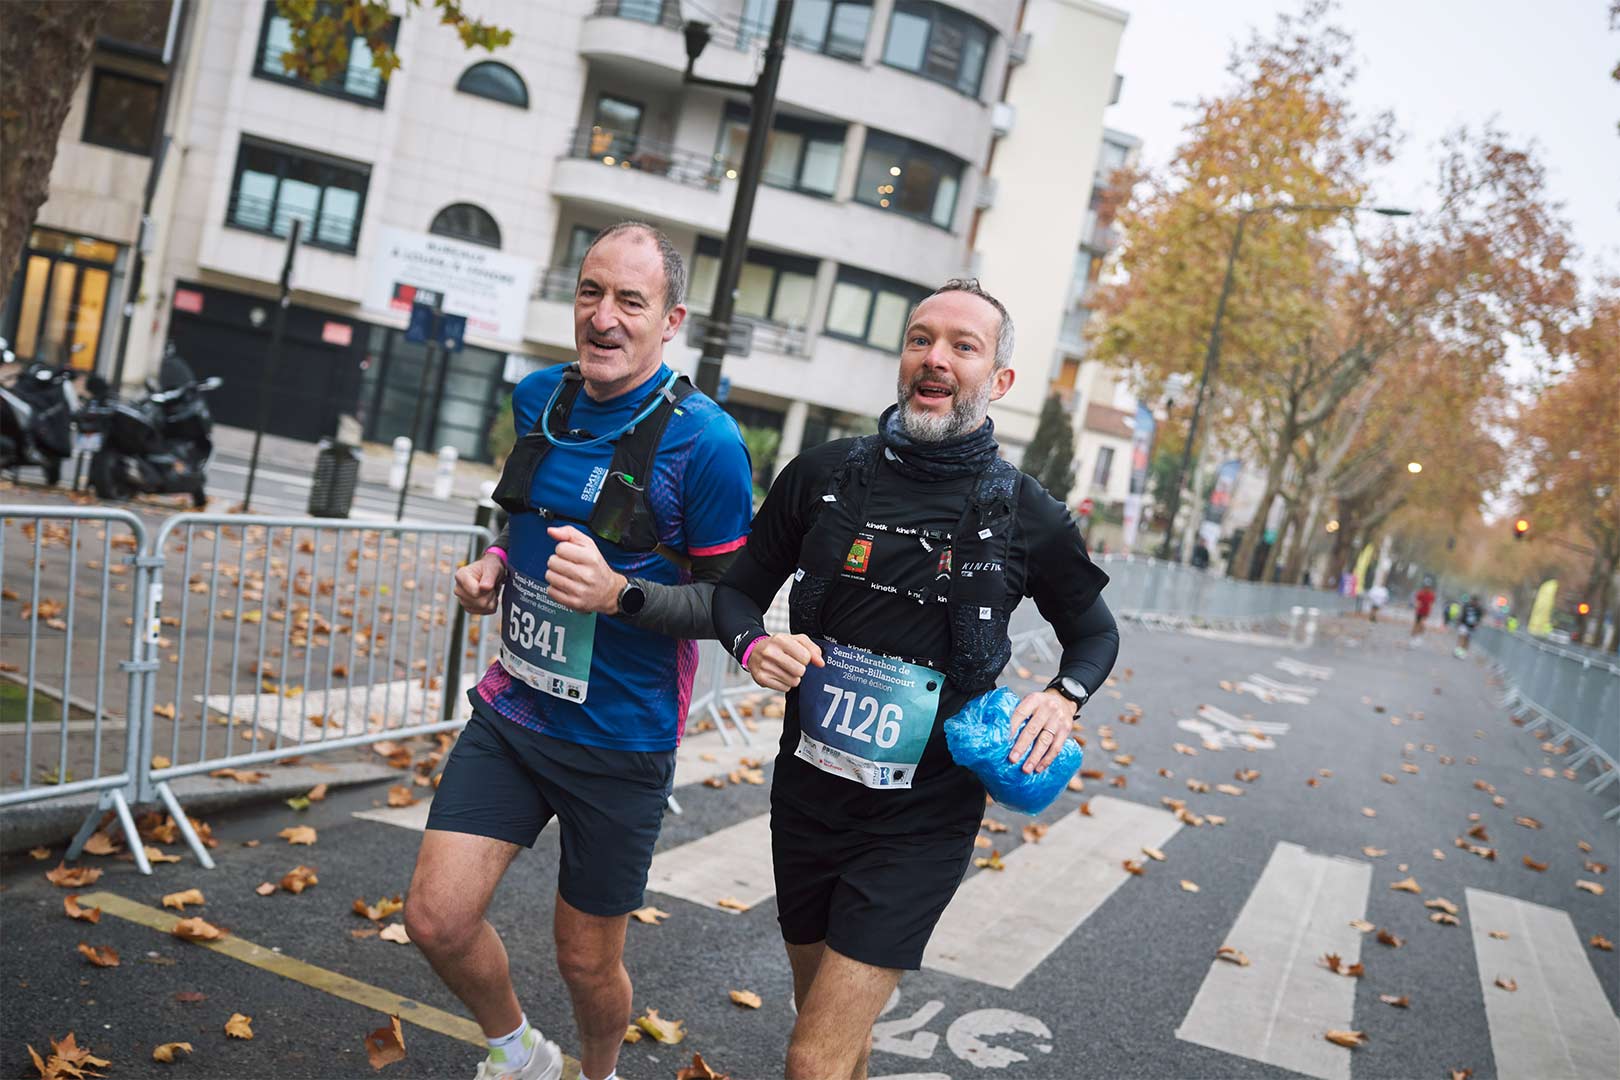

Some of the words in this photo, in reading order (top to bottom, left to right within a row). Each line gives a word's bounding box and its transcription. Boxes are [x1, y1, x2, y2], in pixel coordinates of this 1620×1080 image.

[870, 582, 898, 594] kinetik
[509, 602, 567, 664] 5341
[826, 655, 916, 689] Boulogne-Billancourt
[832, 646, 897, 673] Semi-Marathon
[898, 664, 911, 676] de
[868, 680, 893, 694] édition
[821, 683, 904, 749] 7126
